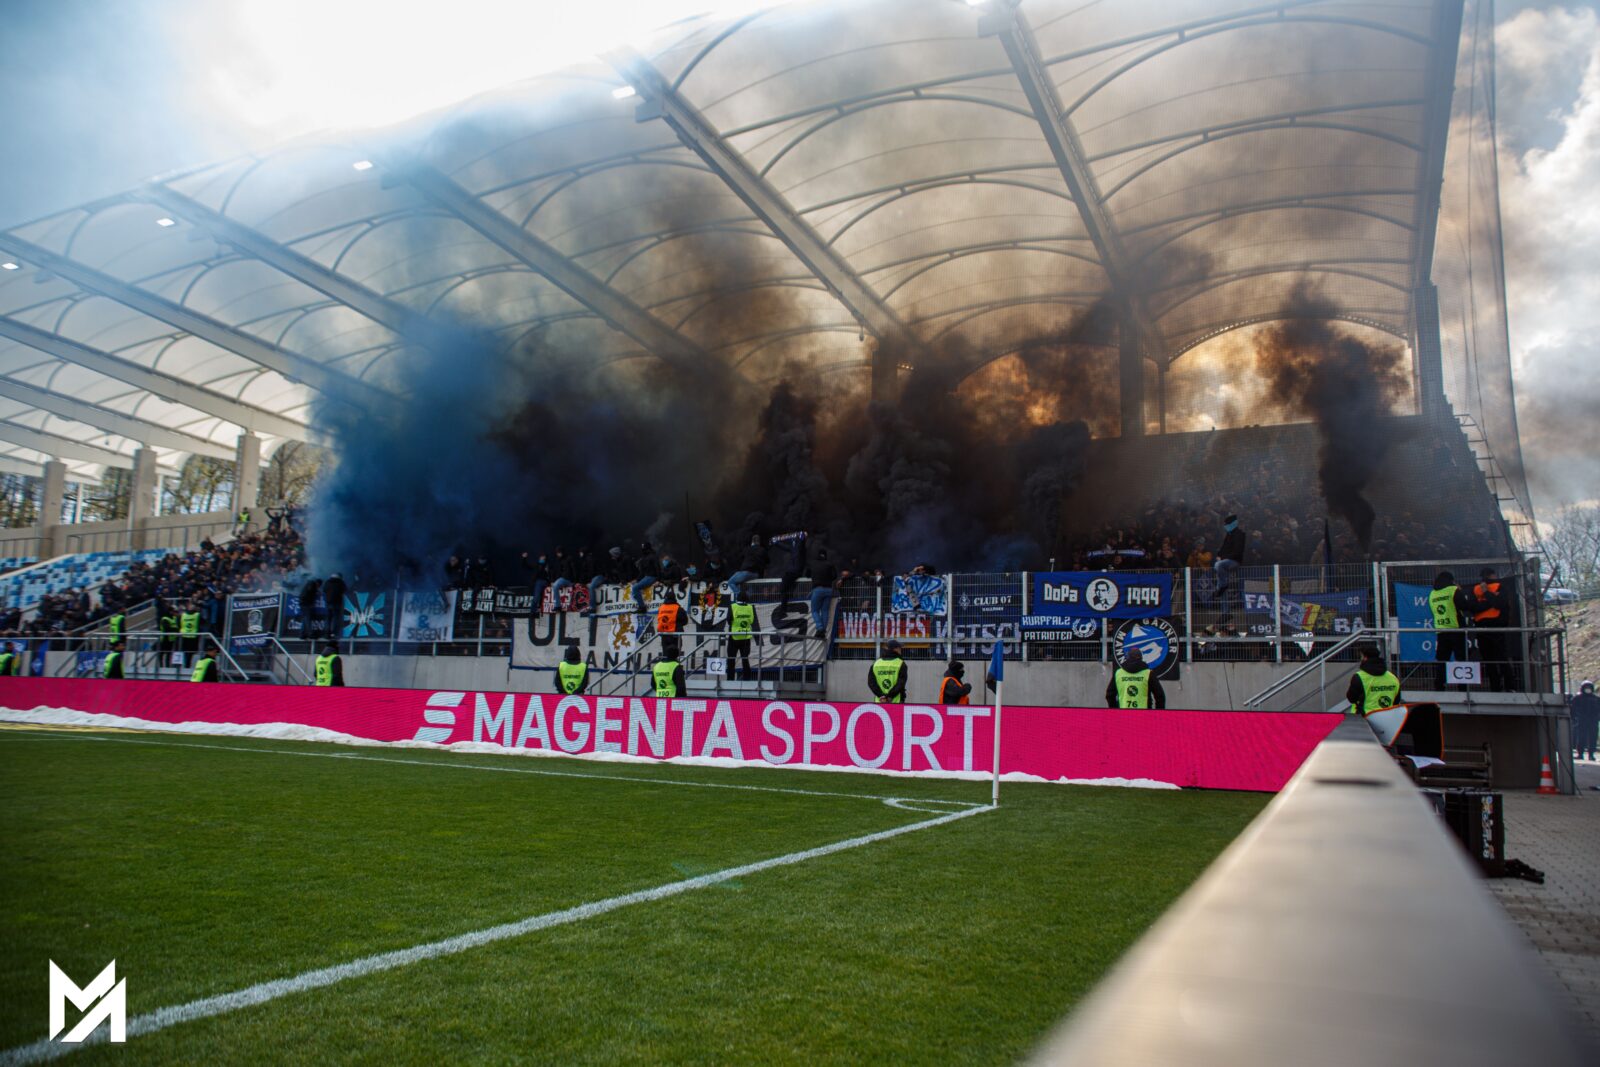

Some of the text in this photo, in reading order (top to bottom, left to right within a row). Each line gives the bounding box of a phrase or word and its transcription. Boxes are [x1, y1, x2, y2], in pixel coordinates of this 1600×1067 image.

[1044, 583, 1160, 606] DoPa 1999
[973, 595, 1012, 606] CLUB 07
[1024, 631, 1072, 641] PATRIOTEN
[710, 661, 723, 672] C2
[1453, 666, 1474, 680] C3
[1127, 700, 1138, 708] 76
[472, 693, 992, 771] MAGENTA SPORT
